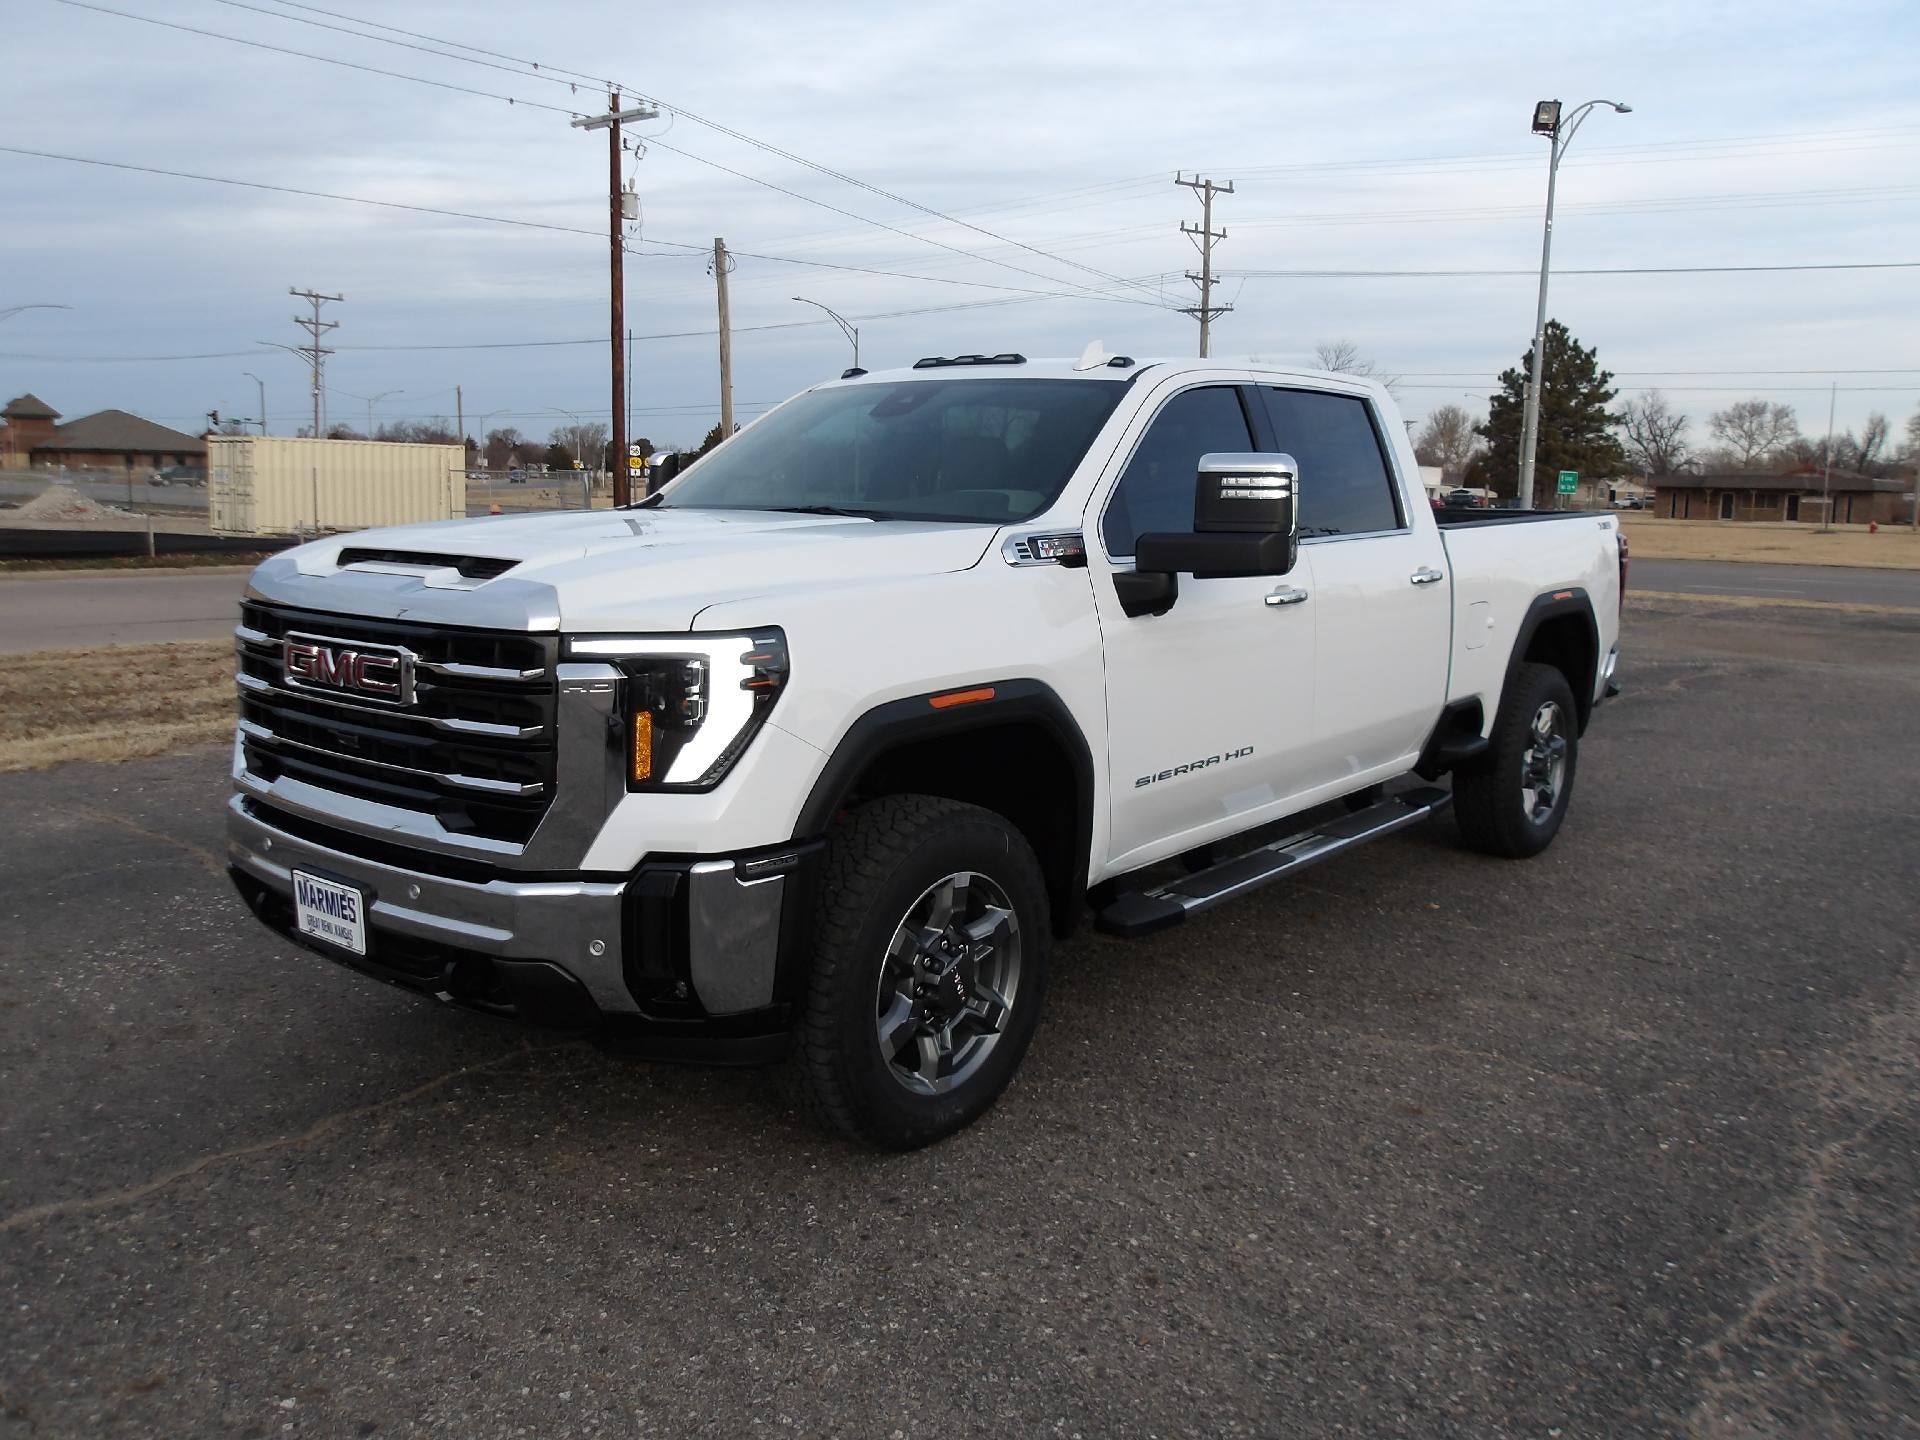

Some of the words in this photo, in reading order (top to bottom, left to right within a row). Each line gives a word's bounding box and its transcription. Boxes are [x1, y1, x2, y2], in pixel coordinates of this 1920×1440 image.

[287, 643, 400, 695] GMC
[1135, 755, 1220, 788] SIERRA
[1225, 746, 1254, 761] HD
[306, 914, 321, 930] GREAT
[335, 923, 354, 942] KANSAS
